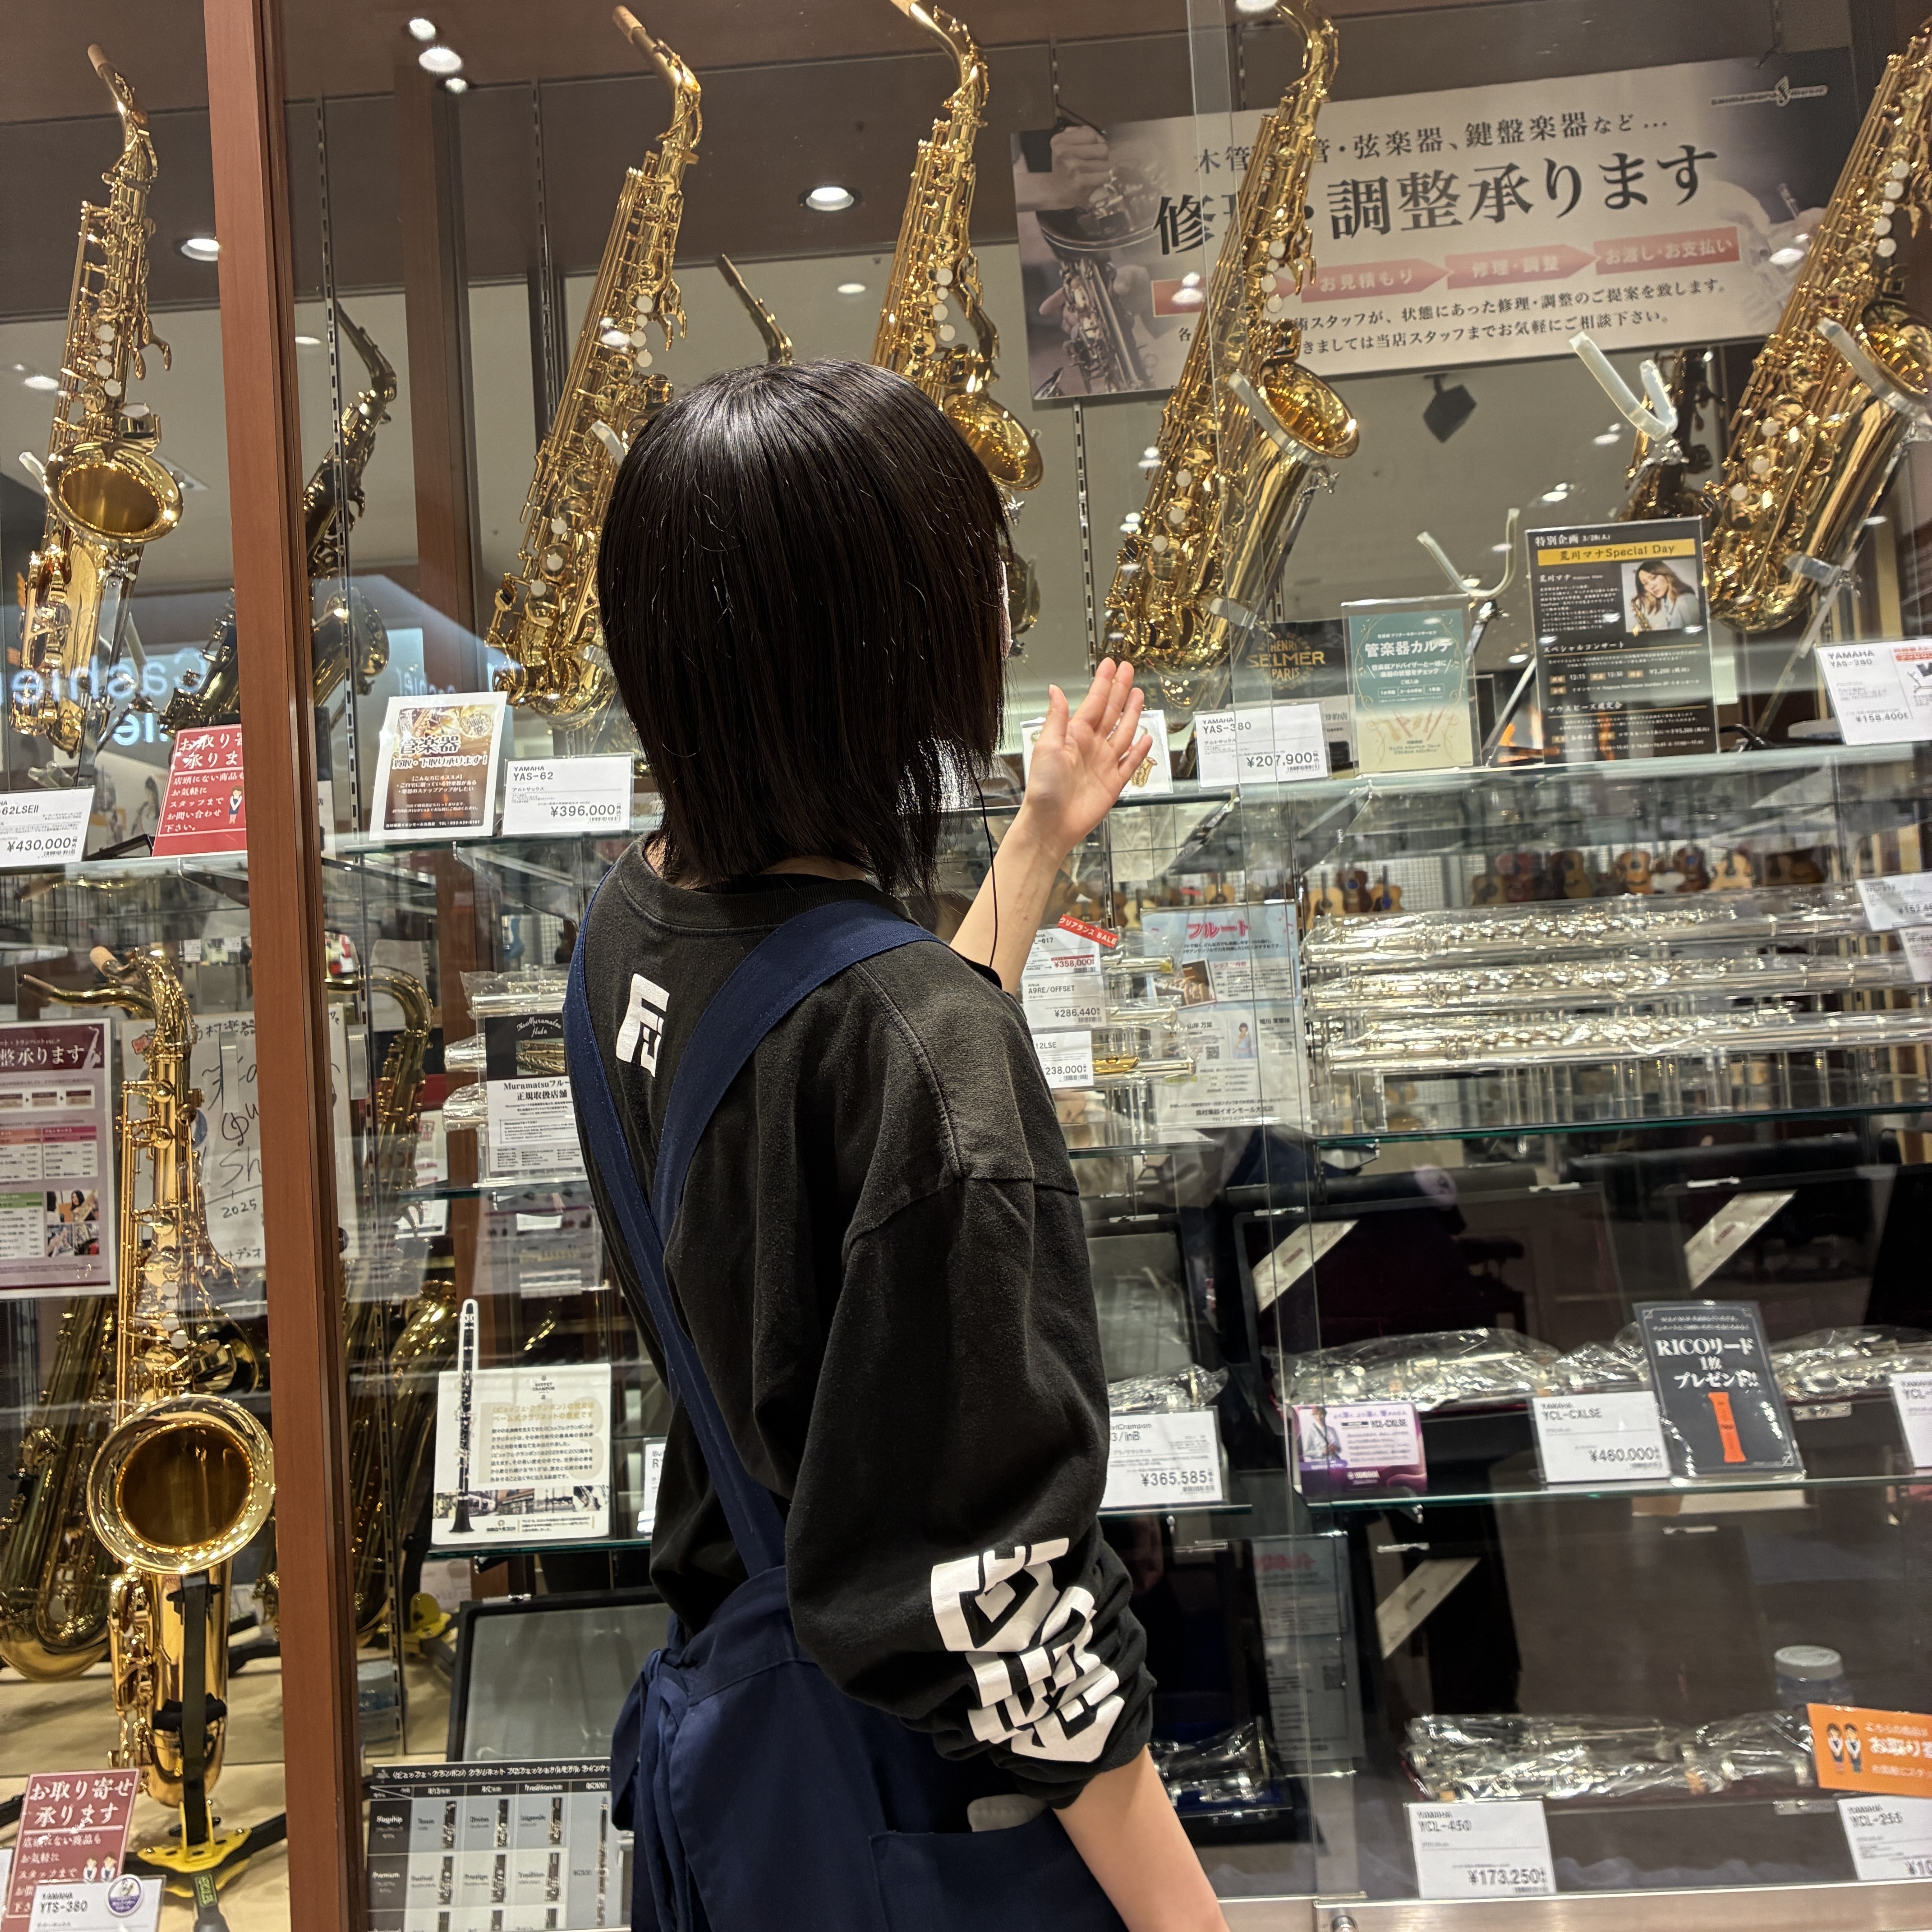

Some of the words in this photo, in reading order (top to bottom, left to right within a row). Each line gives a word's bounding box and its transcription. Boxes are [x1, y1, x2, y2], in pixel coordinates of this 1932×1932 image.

[1195, 111, 1668, 174] 木管管・弦楽器、鍵盤楽器など…
[1154, 144, 1717, 255] 修・調整承ります
[1606, 237, 1732, 265] お渡し・お支払い
[1472, 255, 1559, 278] 修理・調整
[1320, 269, 1413, 292] お見積もり
[1535, 534, 1578, 547] 特別企画
[1653, 544, 1675, 555] Day
[1270, 640, 1297, 652] HENRI
[1365, 639, 1453, 658] 管楽器カルテ
[1246, 651, 1326, 668] SELMER
[1828, 650, 1875, 660] YAMAHA
[1271, 667, 1300, 681] PARIS
[1203, 722, 1251, 734] YAS-380
[400, 734, 461, 755] 管楽器
[183, 750, 238, 769] 承りま
[1247, 752, 1313, 768] ¥207,900
[513, 772, 553, 782] YAS-62
[171, 787, 207, 796] お気軽に
[169, 797, 224, 808] スタッフまで
[167, 809, 222, 820] お問い合わせ
[551, 804, 615, 817] ¥396,000
[165, 824, 196, 833] 下さい。
[7, 837, 71, 852] ¥430,000
[1059, 917, 1095, 936] クリアランス
[1096, 932, 1117, 944] SALE
[1187, 919, 1252, 940] フルート
[1054, 958, 1093, 968] ¥358,000
[1054, 1007, 1096, 1017] ¥286,440
[524, 1017, 562, 1029] Muramatsu
[1044, 1065, 1083, 1075] 238,000
[504, 1079, 570, 1090] Muramatsuフルー
[517, 1090, 567, 1100] 正規取扱店舗
[222, 1199, 257, 1219] 2025
[1655, 1338, 1754, 1356] RICOリード
[1698, 1356, 1722, 1370] 1枚
[1542, 1408, 1602, 1421] YCL-CXLSE
[1589, 1446, 1654, 1462] ¥460,000
[1141, 1470, 1208, 1486] ¥365,585
[29, 1776, 133, 1802] お取り寄せ
[34, 1802, 118, 1827] 承ります
[1419, 1820, 1472, 1832] YCL-450
[1468, 1868, 1541, 1886] ¥173,250
[41, 1891, 73, 1900] YAMAHA
[40, 1900, 88, 1914] YTS-380
